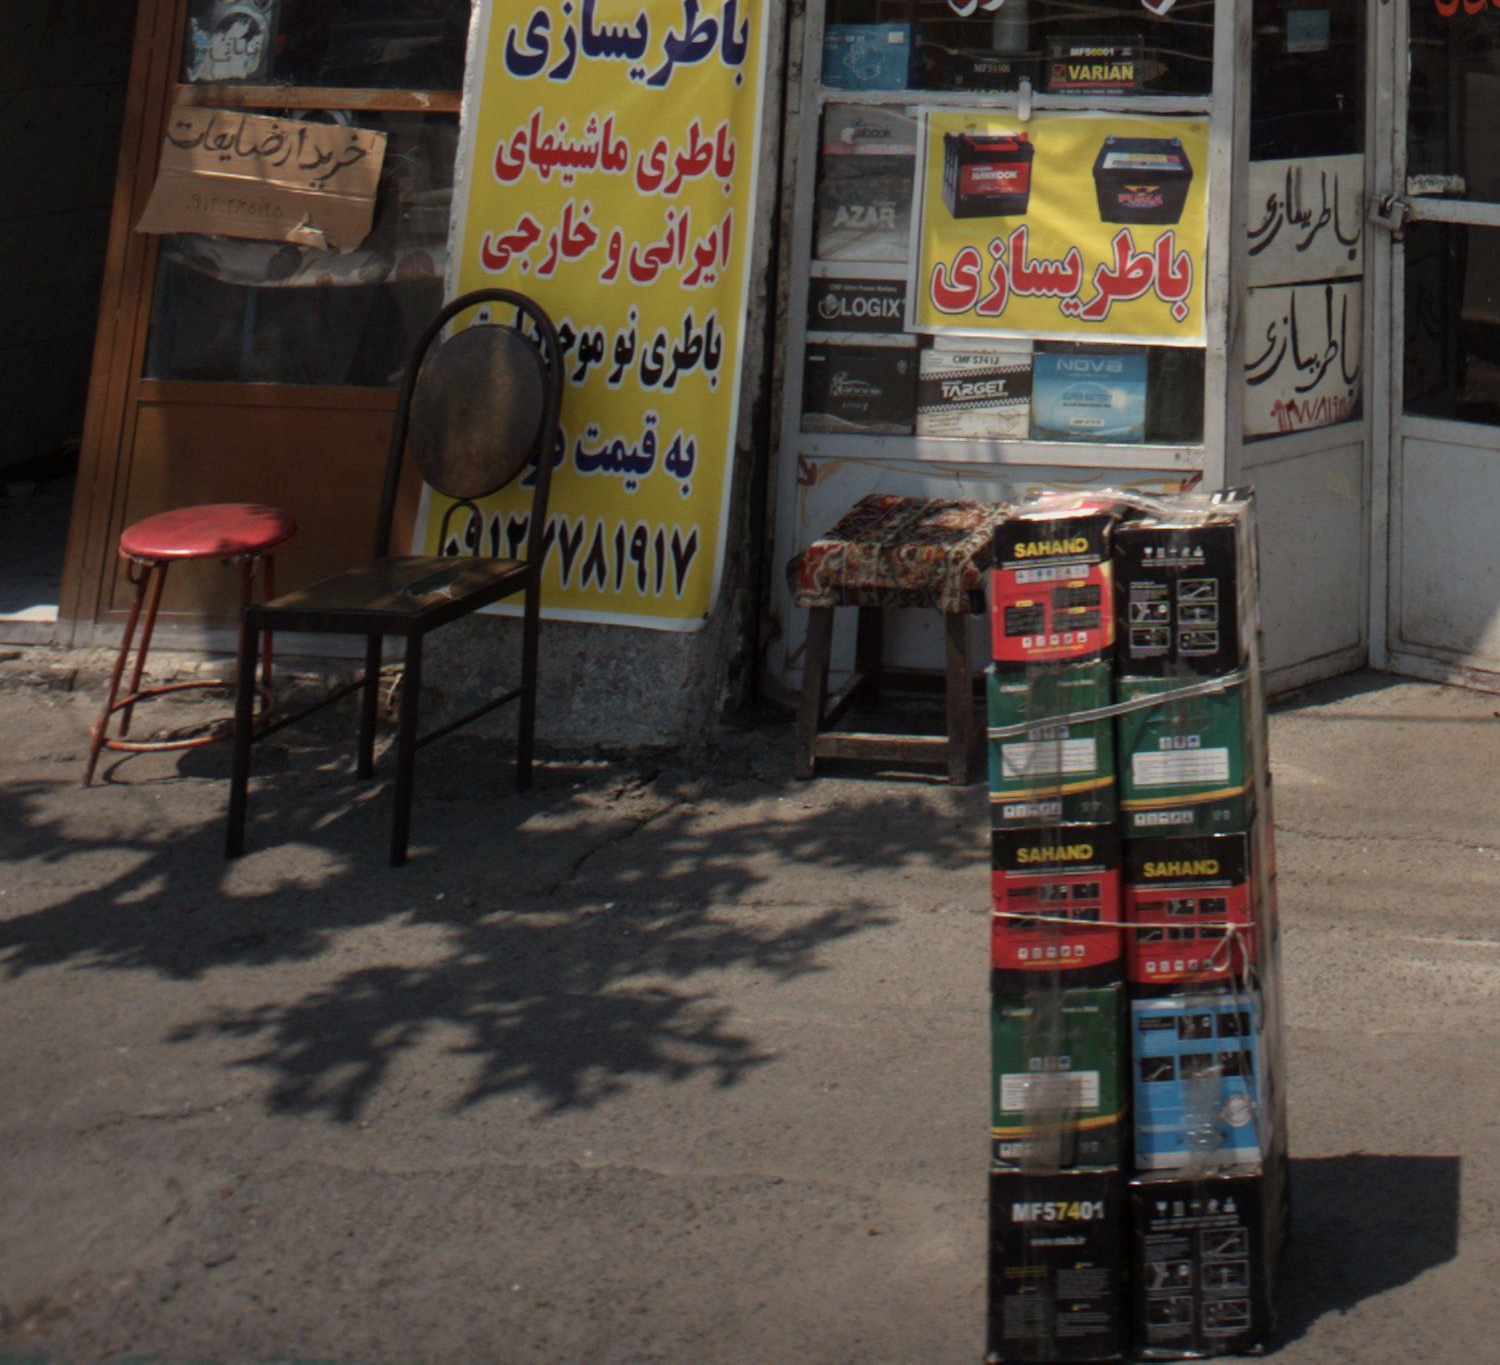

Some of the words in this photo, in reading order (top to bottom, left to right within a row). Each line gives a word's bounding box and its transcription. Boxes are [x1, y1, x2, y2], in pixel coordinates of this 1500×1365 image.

[167, 114, 284, 161] ضایعات
[273, 127, 367, 188] خریدار
[494, 111, 629, 183] ماشینهای
[636, 120, 736, 194] باطری
[481, 202, 598, 275] خارجی
[832, 205, 897, 229] AZAR
[600, 230, 623, 281] و
[629, 210, 732, 286] ایرانی
[931, 226, 1193, 320] باطریسازی
[841, 297, 900, 317] LOGIX
[607, 310, 637, 384] نو
[639, 313, 722, 388] باطری
[941, 379, 1007, 398] TARGET
[574, 413, 657, 490] قیمت
[664, 433, 696, 495] به
[1014, 537, 1089, 558] SAHAND
[1016, 844, 1093, 863] SAHAND
[1143, 858, 1220, 878] SAHAND
[1011, 1200, 1105, 1223] MF57401
